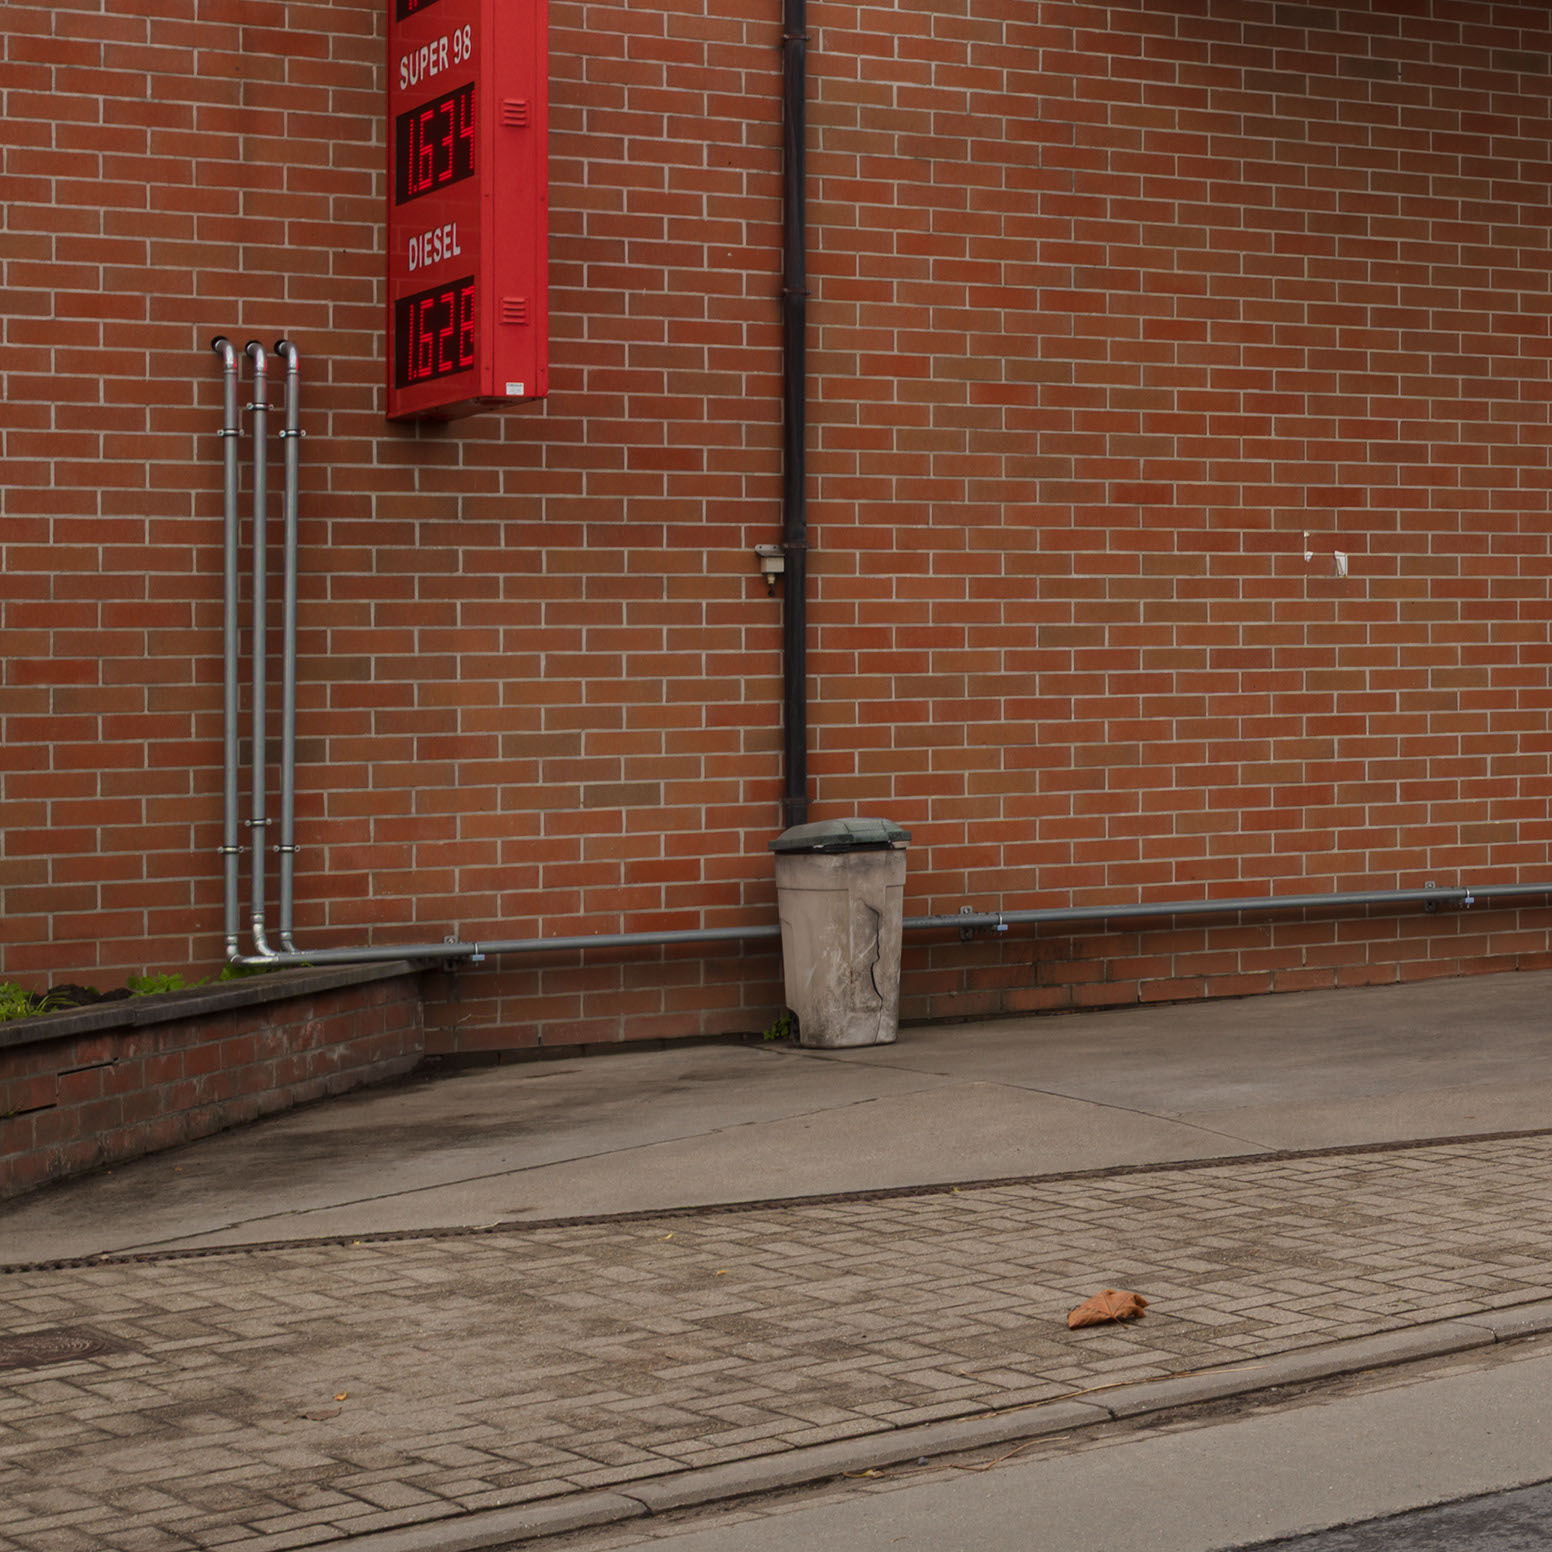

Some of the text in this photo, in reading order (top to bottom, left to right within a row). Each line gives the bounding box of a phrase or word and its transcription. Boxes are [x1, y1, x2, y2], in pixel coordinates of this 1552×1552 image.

[400, 24, 472, 91] SUPER 98
[408, 89, 475, 196] 1.634
[408, 221, 461, 272] DIESEL
